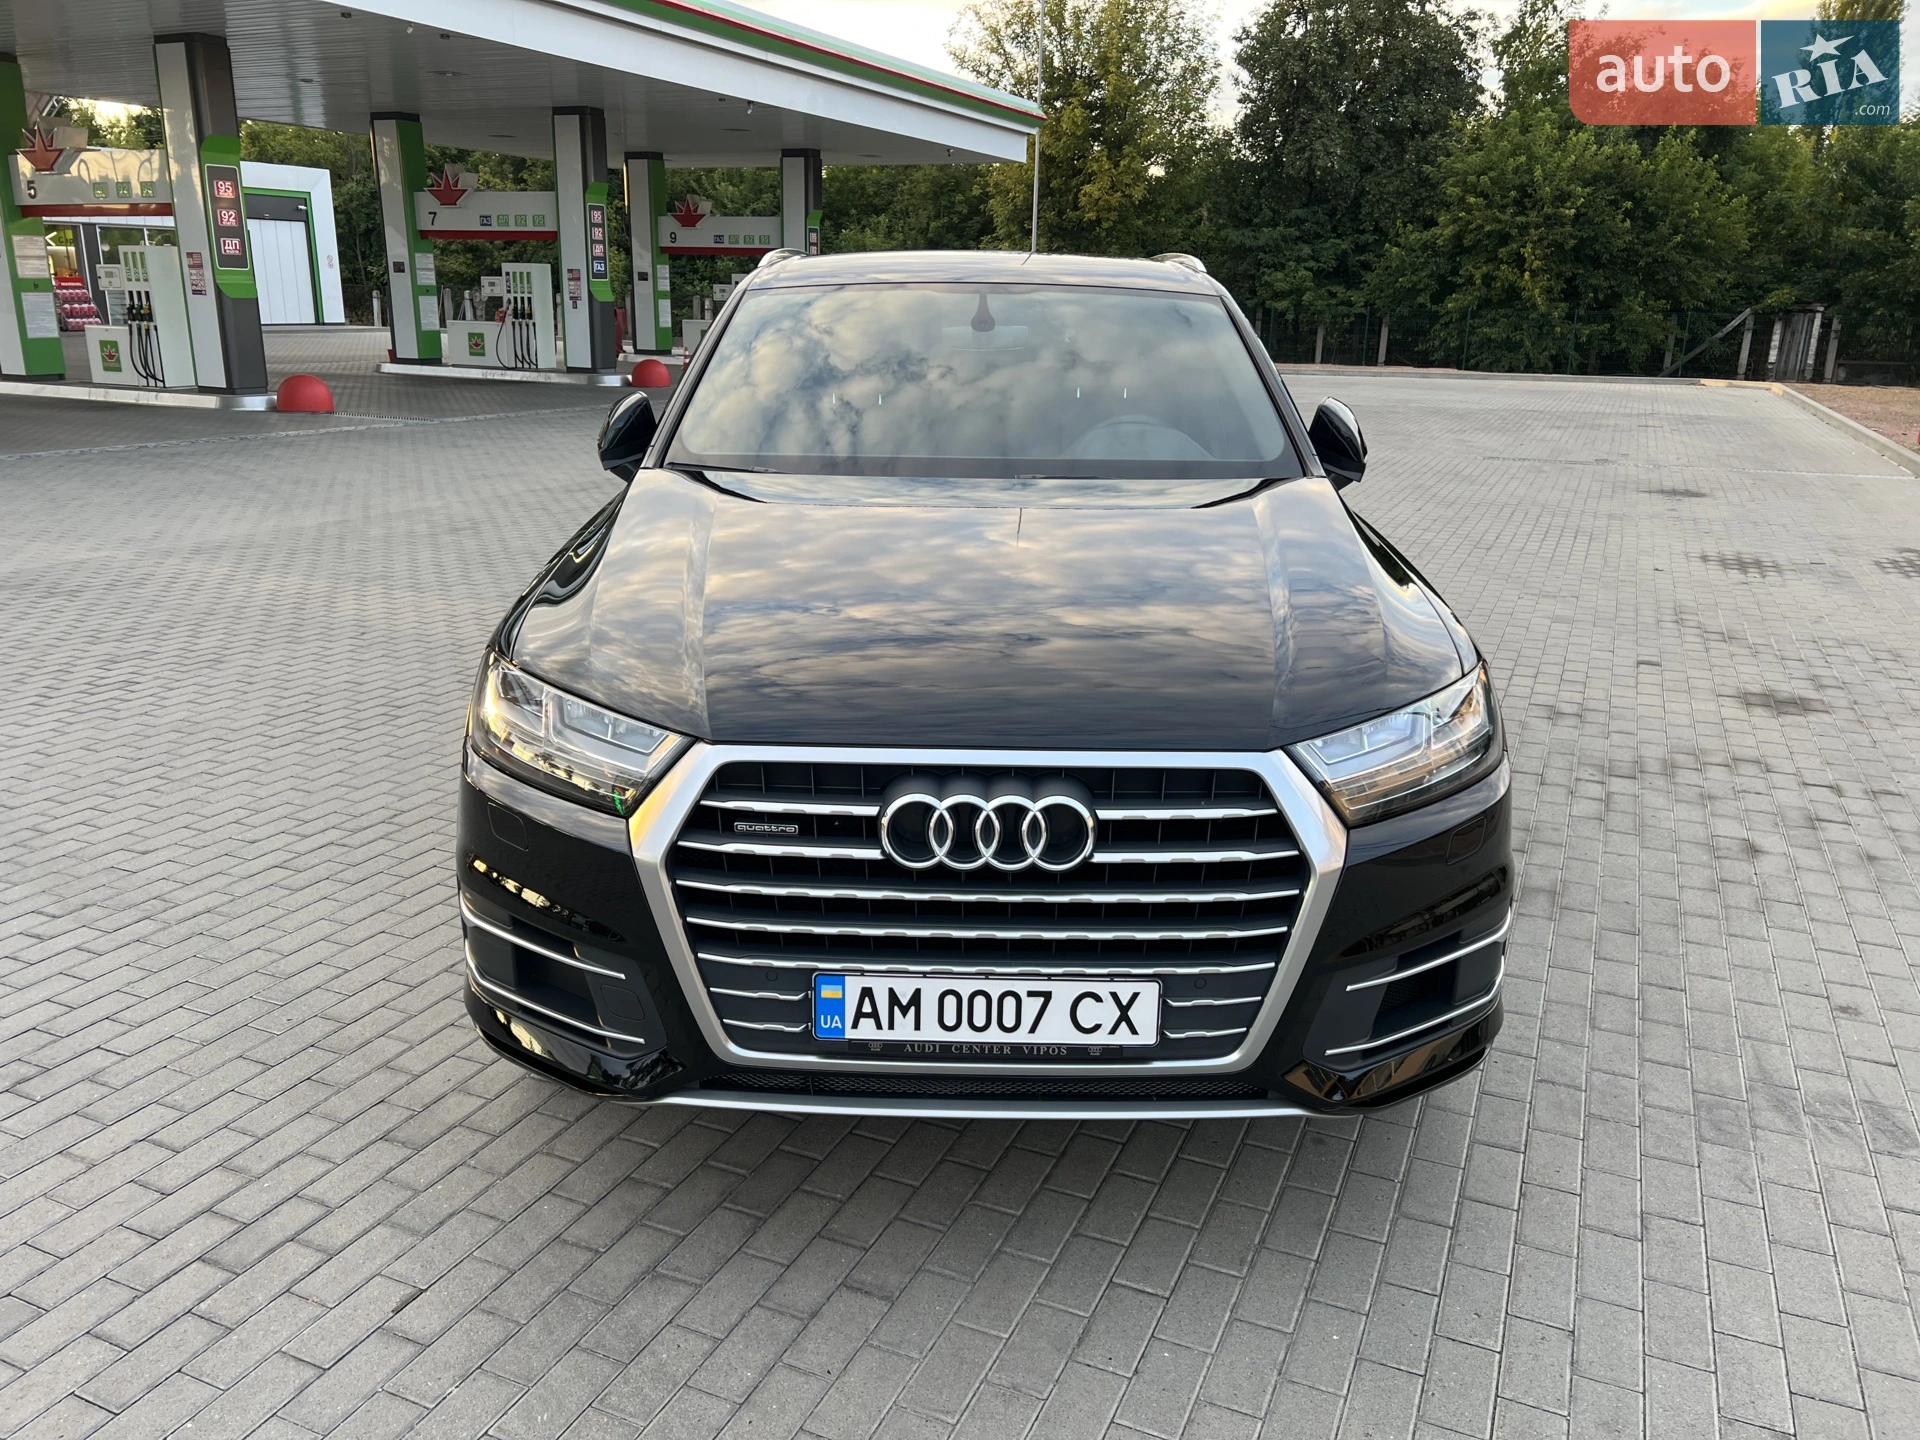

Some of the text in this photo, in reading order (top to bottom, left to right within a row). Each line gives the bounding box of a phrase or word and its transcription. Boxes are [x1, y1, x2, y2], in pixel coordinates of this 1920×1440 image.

[26, 180, 37, 199] 5
[217, 181, 233, 193] 95
[221, 210, 236, 222] 92
[428, 211, 437, 226] 7
[480, 215, 544, 225] ГАЗ ДП 92 95
[593, 210, 602, 220] 95
[594, 227, 603, 237] 92
[669, 231, 677, 244] 9
[225, 240, 240, 250] ДП
[595, 263, 605, 271] ГАЗ
[737, 824, 795, 832] quattro
[850, 986, 1141, 1036] AM 0007 CX
[820, 1014, 842, 1029] UA
[904, 1043, 1068, 1056] AUDI CENTER VIPOS
